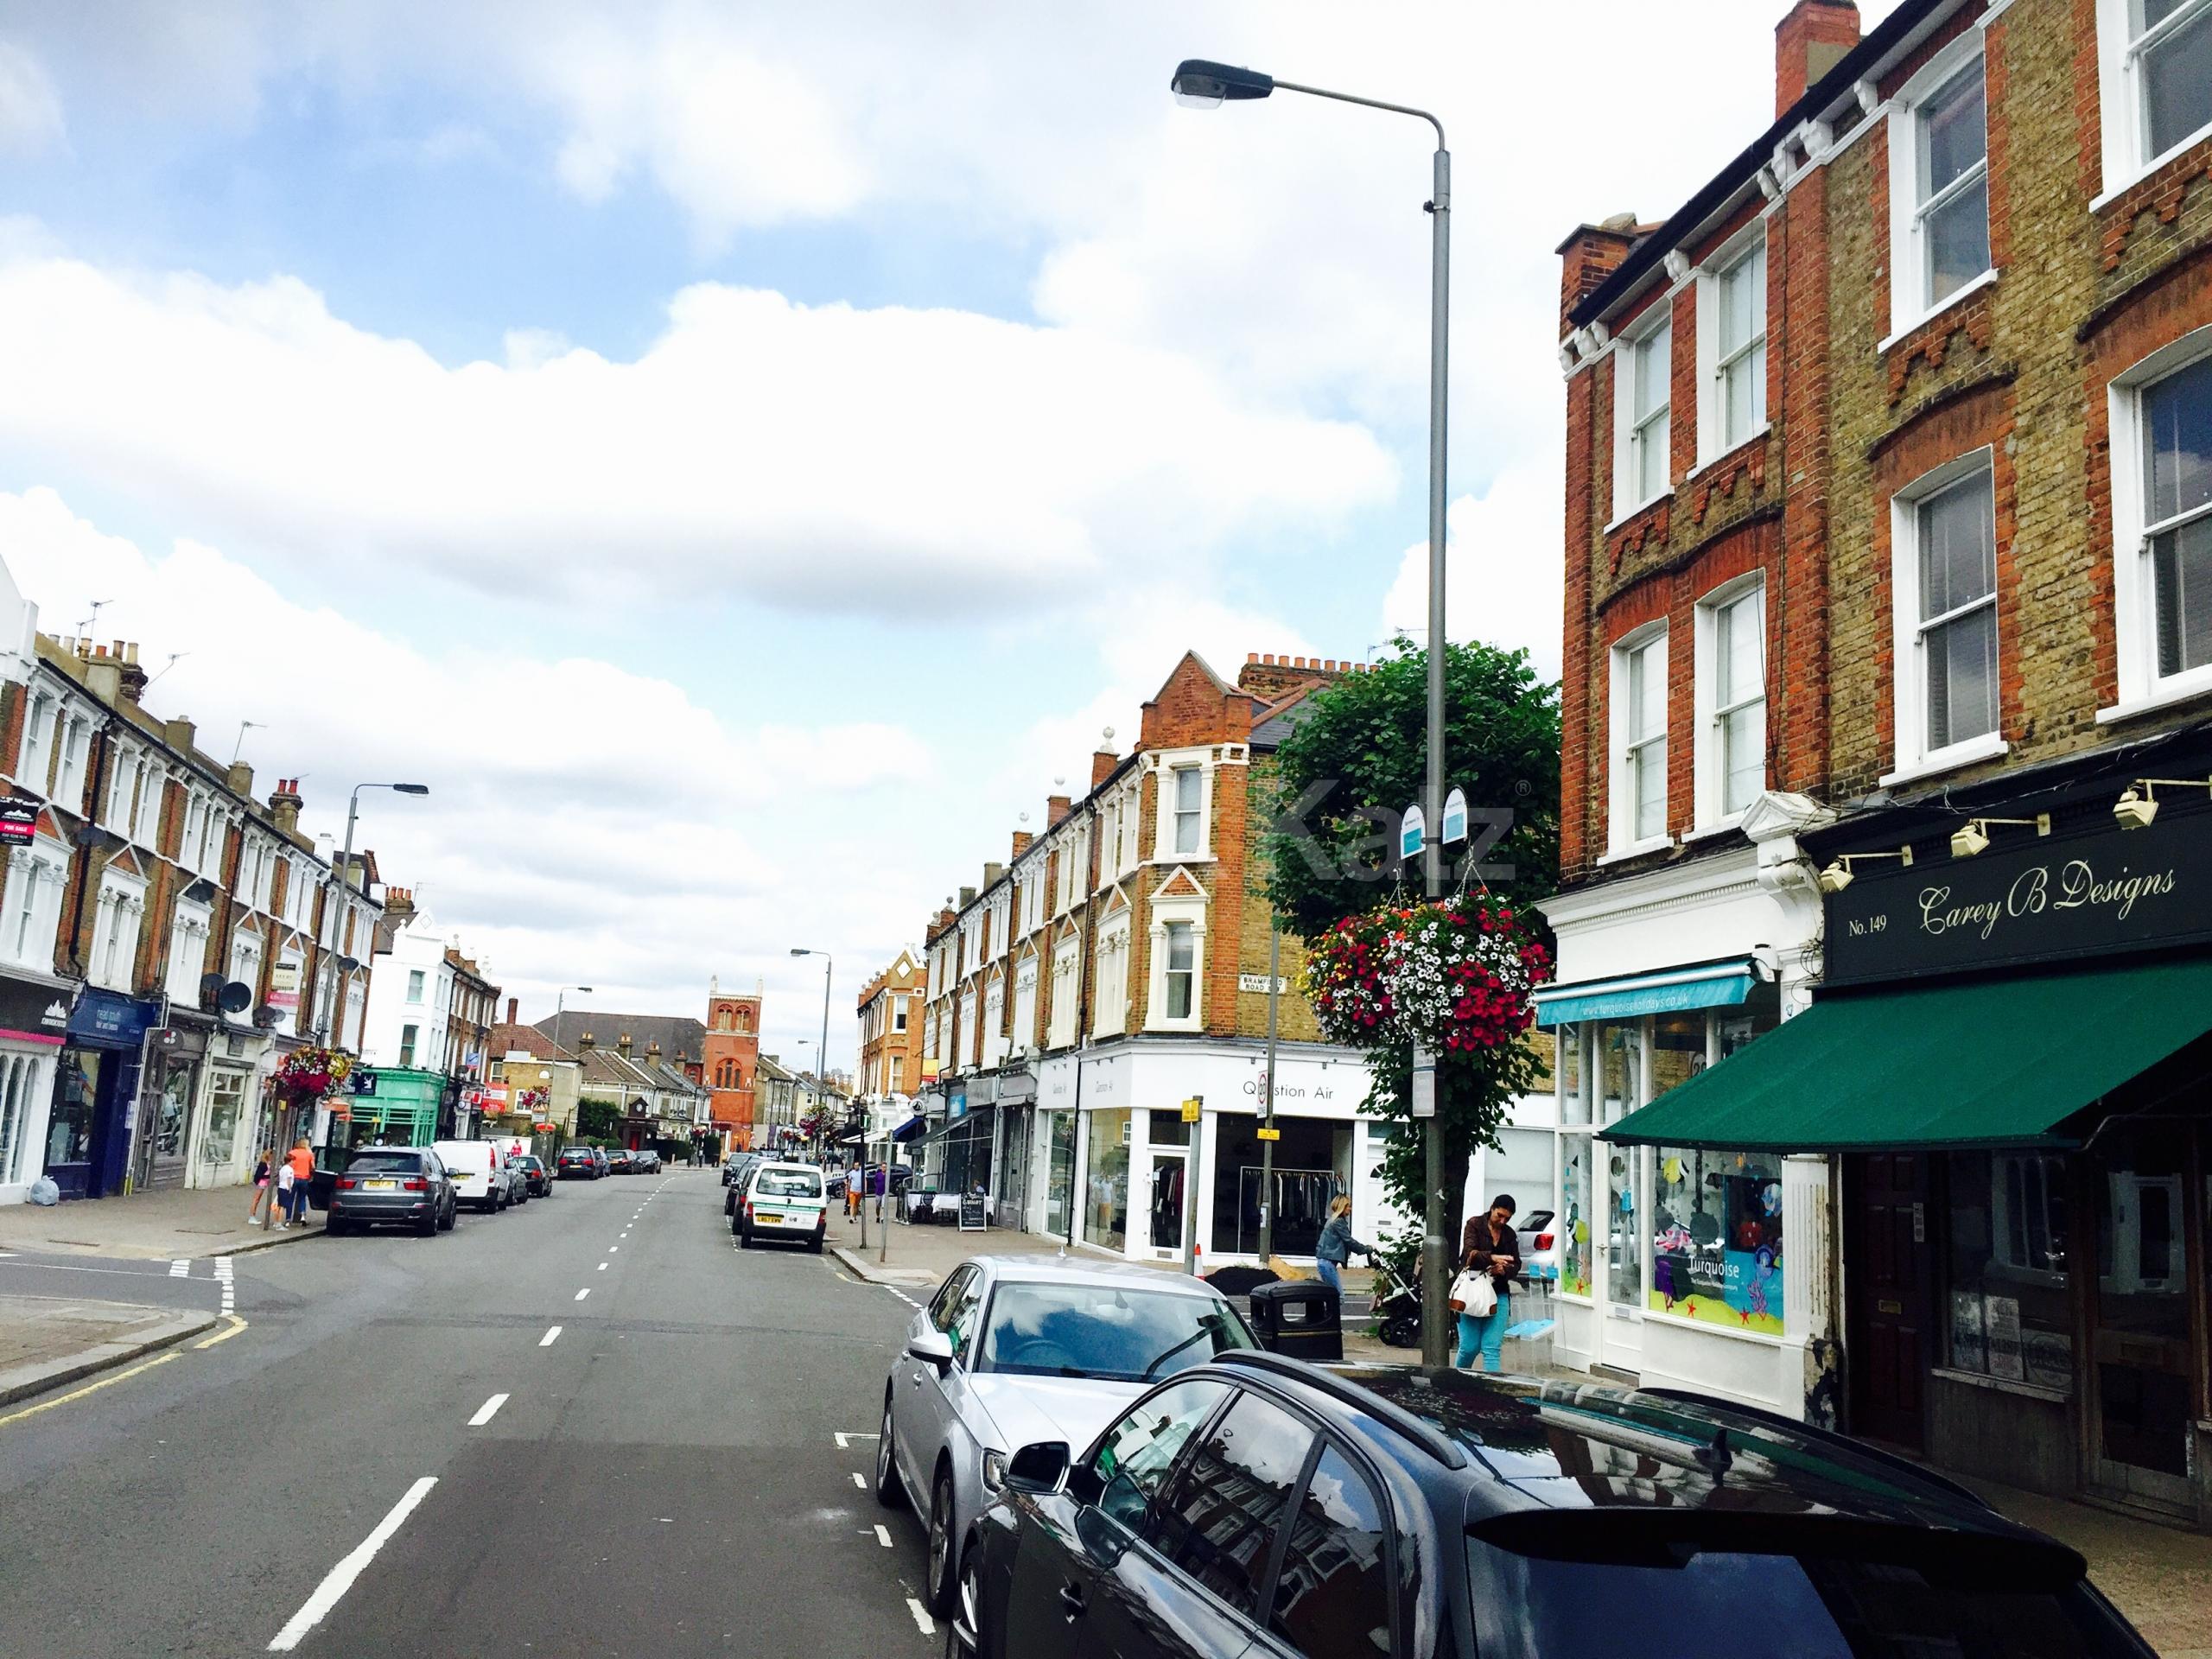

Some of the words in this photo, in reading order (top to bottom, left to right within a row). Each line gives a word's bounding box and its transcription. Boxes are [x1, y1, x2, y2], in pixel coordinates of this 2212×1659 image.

[1919, 886, 2002, 940] Carey
[2007, 865, 2049, 917] B
[2053, 859, 2176, 920] Designs
[1849, 918, 1867, 937] No.
[1869, 914, 1887, 933] 149
[1243, 976, 1283, 986] BRAMFID
[1243, 1080, 1306, 1098] Qstion
[1313, 1086, 1333, 1100] Air
[1688, 1255, 1740, 1279] Turquoise
